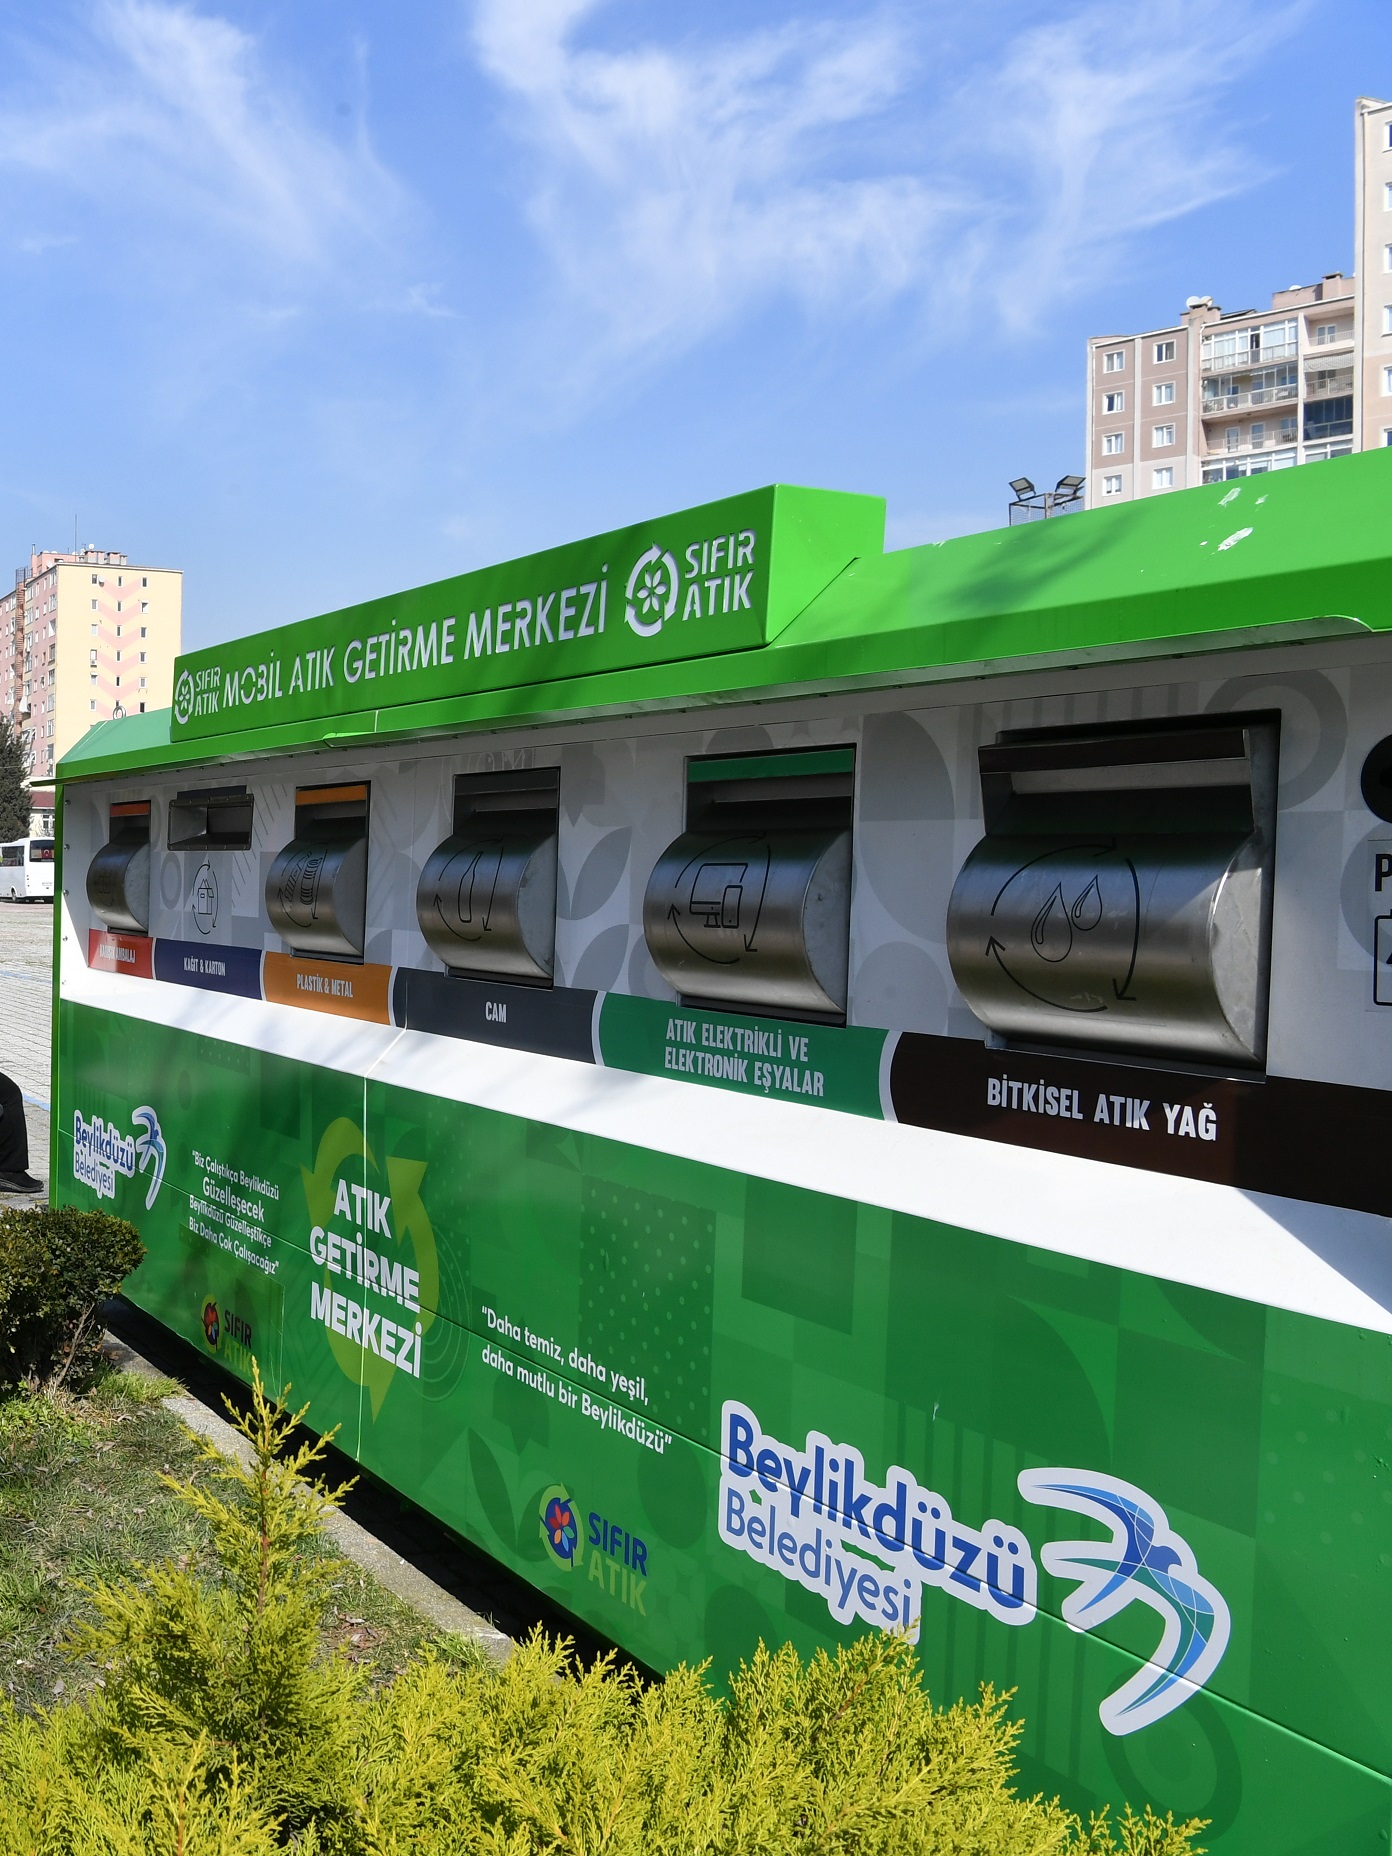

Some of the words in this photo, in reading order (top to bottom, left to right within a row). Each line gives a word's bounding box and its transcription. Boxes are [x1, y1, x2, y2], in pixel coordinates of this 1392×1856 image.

[684, 528, 756, 579] SIFIR
[681, 569, 753, 622] ATIK
[222, 648, 283, 709] MOBİL
[288, 645, 336, 695] ATIK
[343, 616, 456, 684] GETİRME
[463, 562, 609, 660] MERKEZİ
[194, 690, 220, 717] ATIK
[195, 664, 221, 692] SIFIR
[183, 955, 199, 972] KAĞIT
[199, 959, 204, 973] &
[204, 961, 226, 977] KARTON
[296, 973, 323, 994] PLASTİK
[324, 978, 330, 994] &
[331, 979, 354, 999] METAL
[485, 1001, 507, 1024] CAM
[666, 1018, 697, 1044] ATIK
[701, 1023, 782, 1058] ELEKTRİKLİ
[788, 1035, 809, 1062] VE
[664, 1046, 749, 1083] ELEKTRONİK
[753, 1061, 825, 1098] EŞYALAR
[987, 1073, 1083, 1120] BİTKİSEL
[1093, 1093, 1151, 1131] ATIK
[1162, 1102, 1218, 1142] YAĞ
[75, 1115, 135, 1172] Beylikdüzü
[75, 1151, 115, 1194] Belediyesi
[205, 1156, 238, 1184] Çalıştıkça
[239, 1170, 280, 1201] Beylikdüzü
[189, 1194, 224, 1223] Beylikdüzü
[225, 1212, 272, 1249] Güzelleştikçe
[202, 1176, 265, 1223] Güzelleşecek
[333, 1178, 392, 1239] ATIK
[189, 1216, 199, 1234] Biz
[199, 1222, 218, 1244] Daha
[218, 1232, 233, 1252] Çok
[309, 1225, 421, 1314] GETİRME
[224, 1309, 253, 1350] SIFIR
[310, 1281, 422, 1379] MERKEZİ
[223, 1335, 252, 1377] ATIK
[481, 1344, 514, 1377] daha
[516, 1366, 555, 1398] mutlu
[558, 1380, 578, 1409] bir
[524, 1326, 565, 1366] temiz,
[568, 1347, 606, 1383] daha
[610, 1371, 649, 1406] yeşil,
[728, 1413, 1025, 1609] Beylikdüzü
[588, 1511, 647, 1577] SIFIR
[725, 1487, 913, 1628] Belediyesi
[588, 1549, 647, 1617] ATIK
